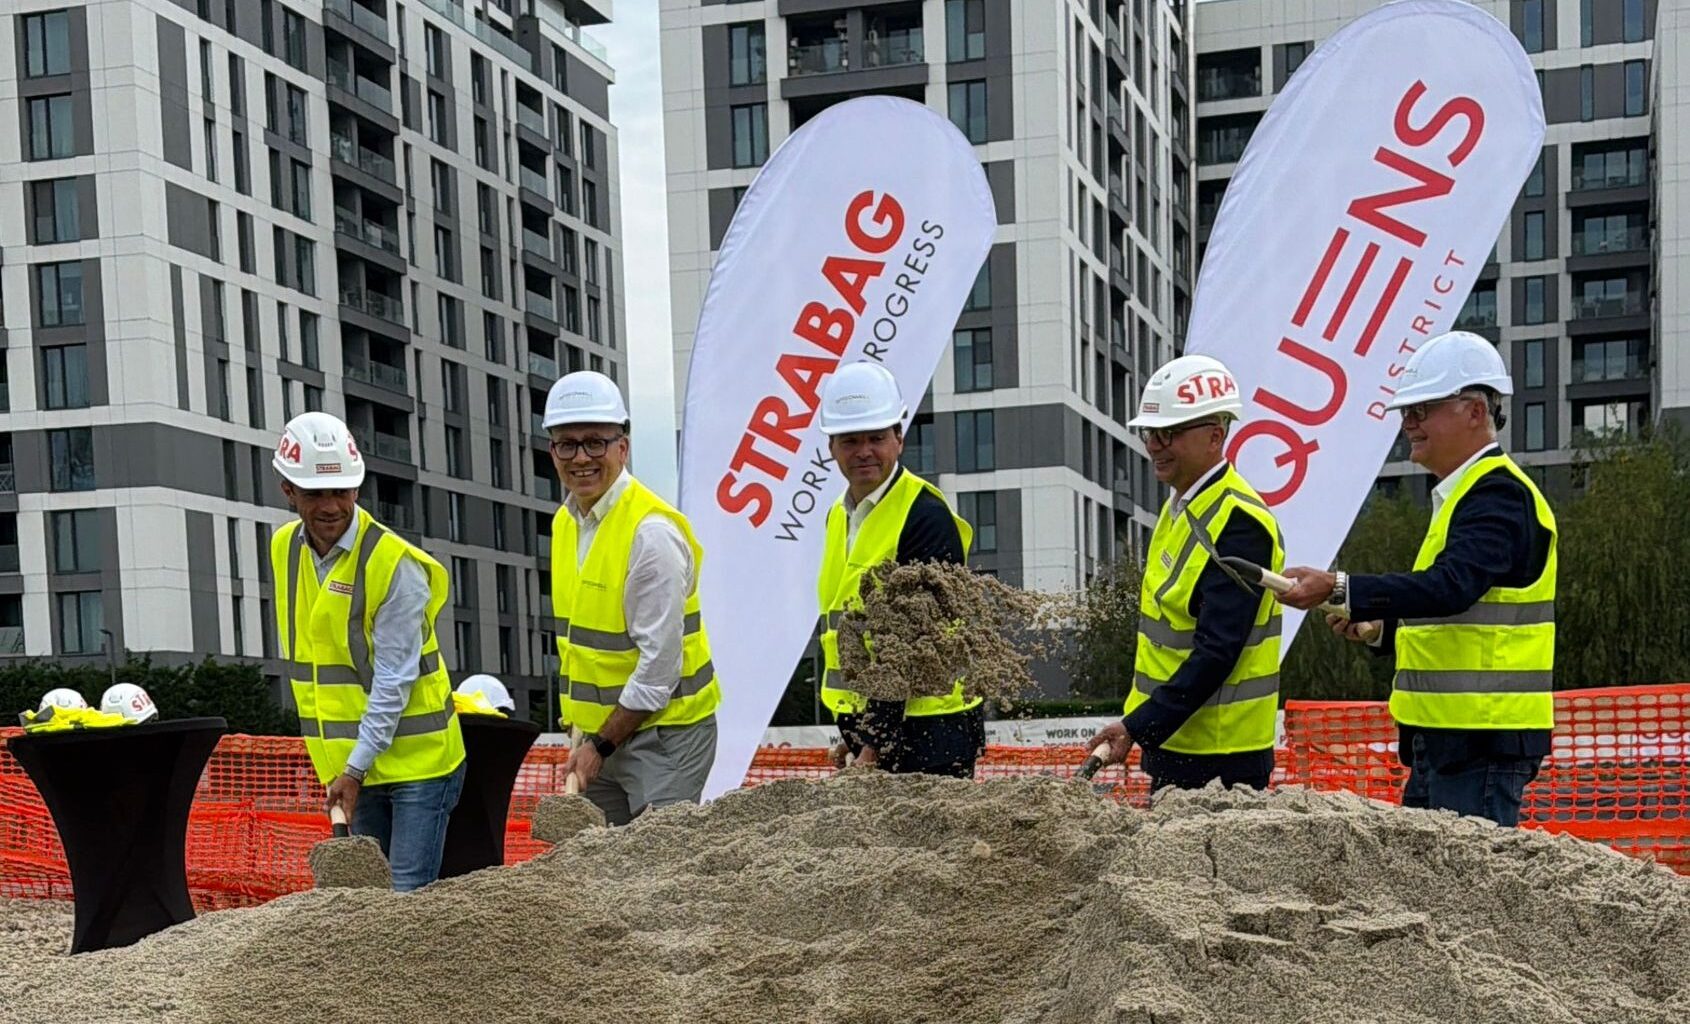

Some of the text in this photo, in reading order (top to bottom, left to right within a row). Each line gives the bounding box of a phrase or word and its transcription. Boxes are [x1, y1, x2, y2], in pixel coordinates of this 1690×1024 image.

[716, 190, 905, 528] STRABAG
[775, 220, 943, 541] WORK ROGRESS
[1177, 375, 1235, 404] STRA
[1367, 249, 1465, 420] DISTRICT
[1045, 727, 1096, 739] WORK ON
